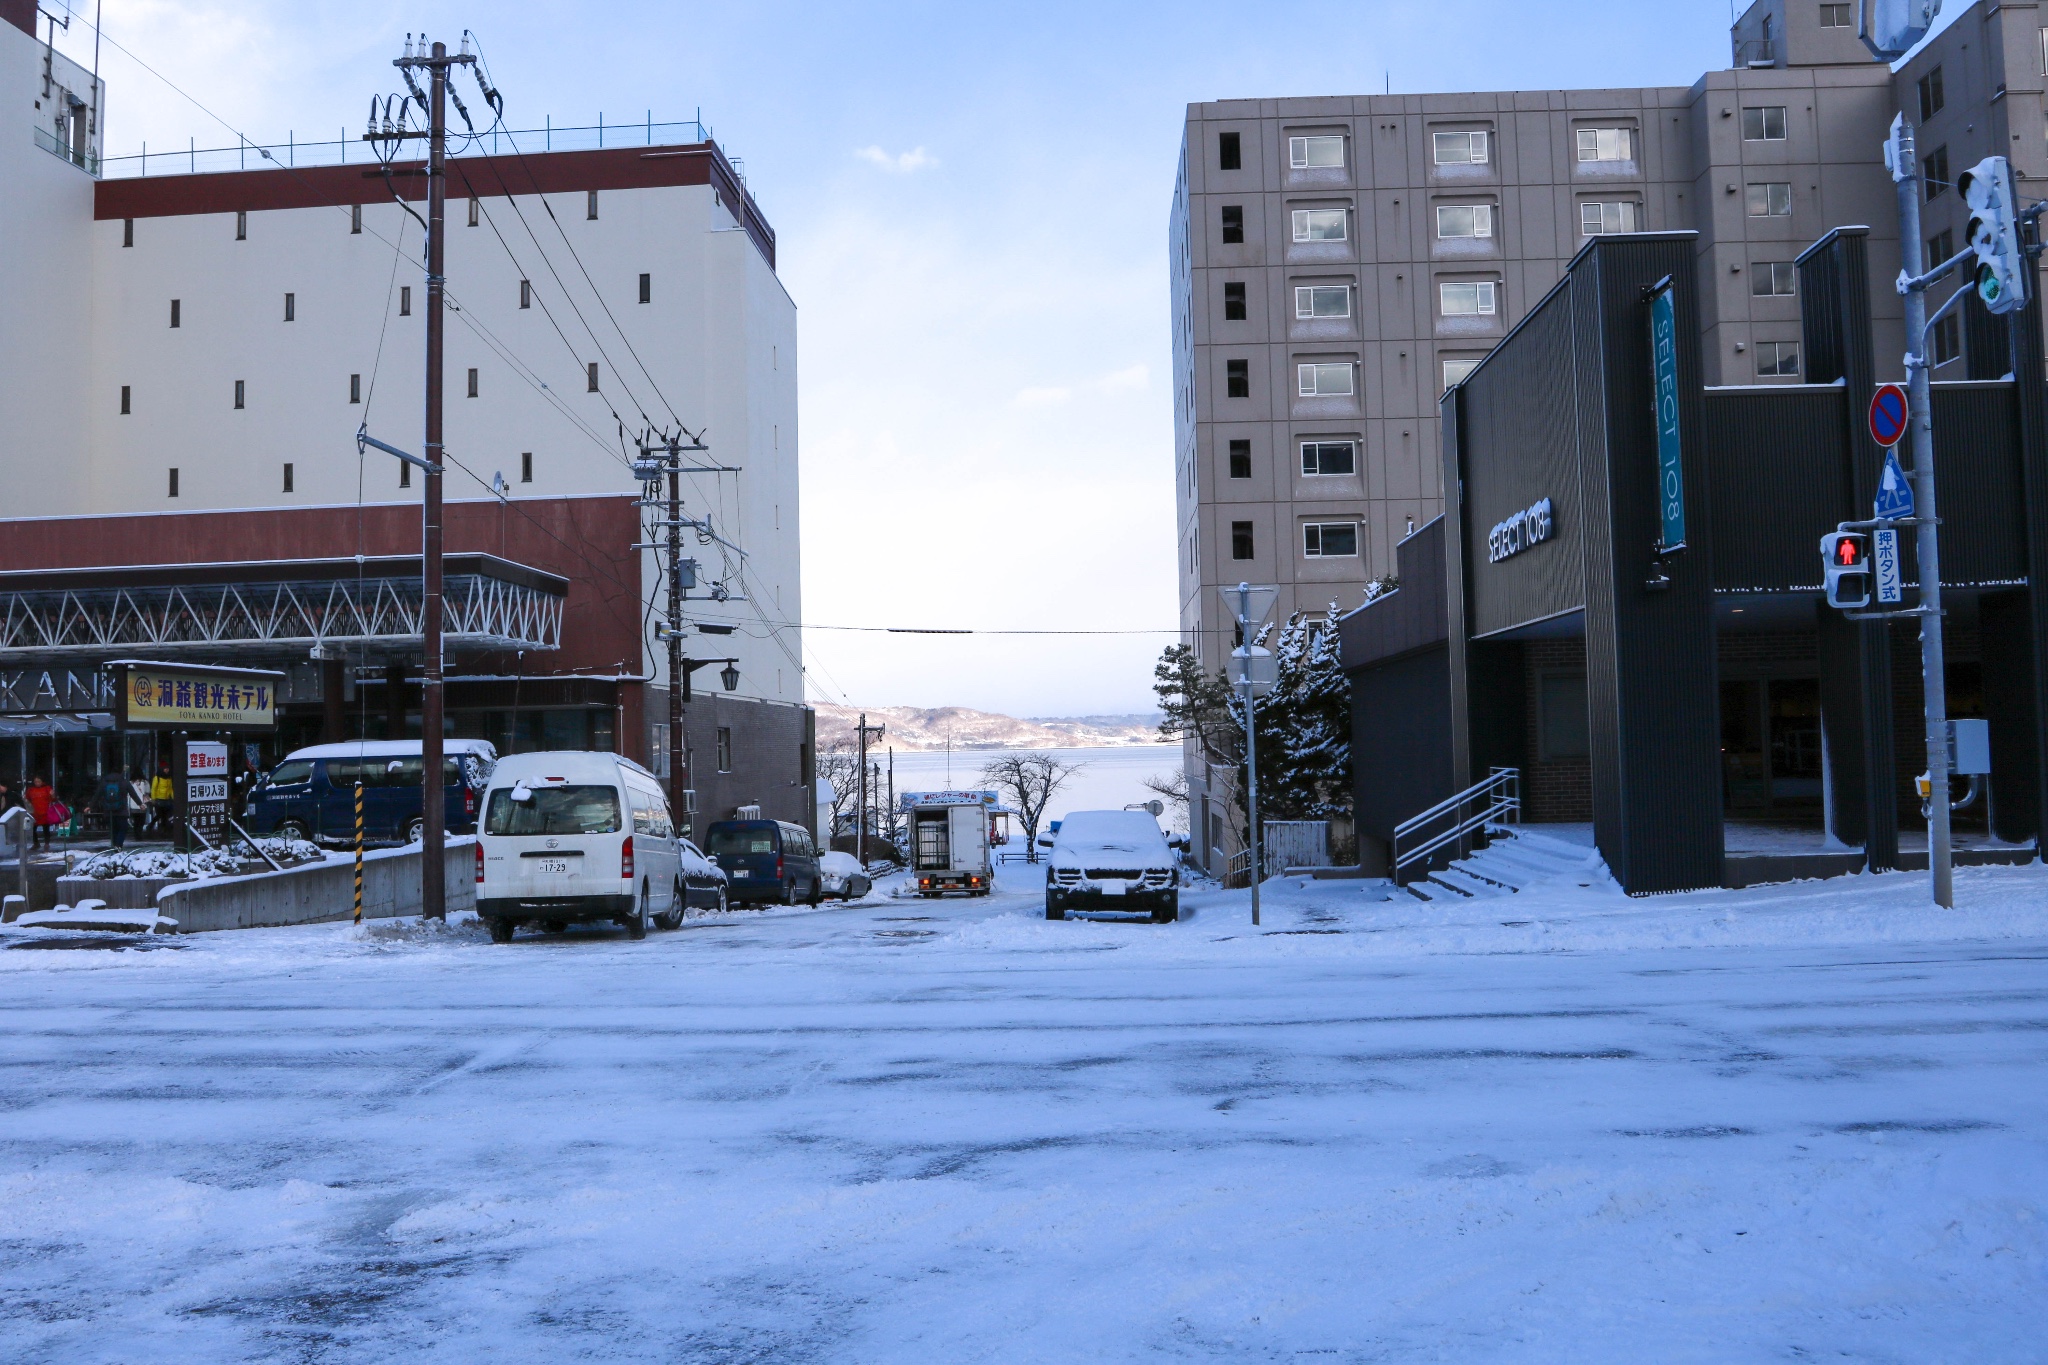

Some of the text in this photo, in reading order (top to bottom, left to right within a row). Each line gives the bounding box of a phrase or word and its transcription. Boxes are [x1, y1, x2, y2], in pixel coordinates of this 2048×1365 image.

[1658, 319, 1680, 521] SELECT 108
[1488, 505, 1546, 564] SELECT 108
[1878, 531, 1896, 600] 押ボタン式
[158, 679, 269, 711] 洞爺観光ホテル
[179, 711, 243, 721] TOYA KANKO HOTEL
[190, 752, 226, 768] 空室あります
[190, 784, 225, 799] 日帰り入浴
[545, 863, 566, 872] 17-29
